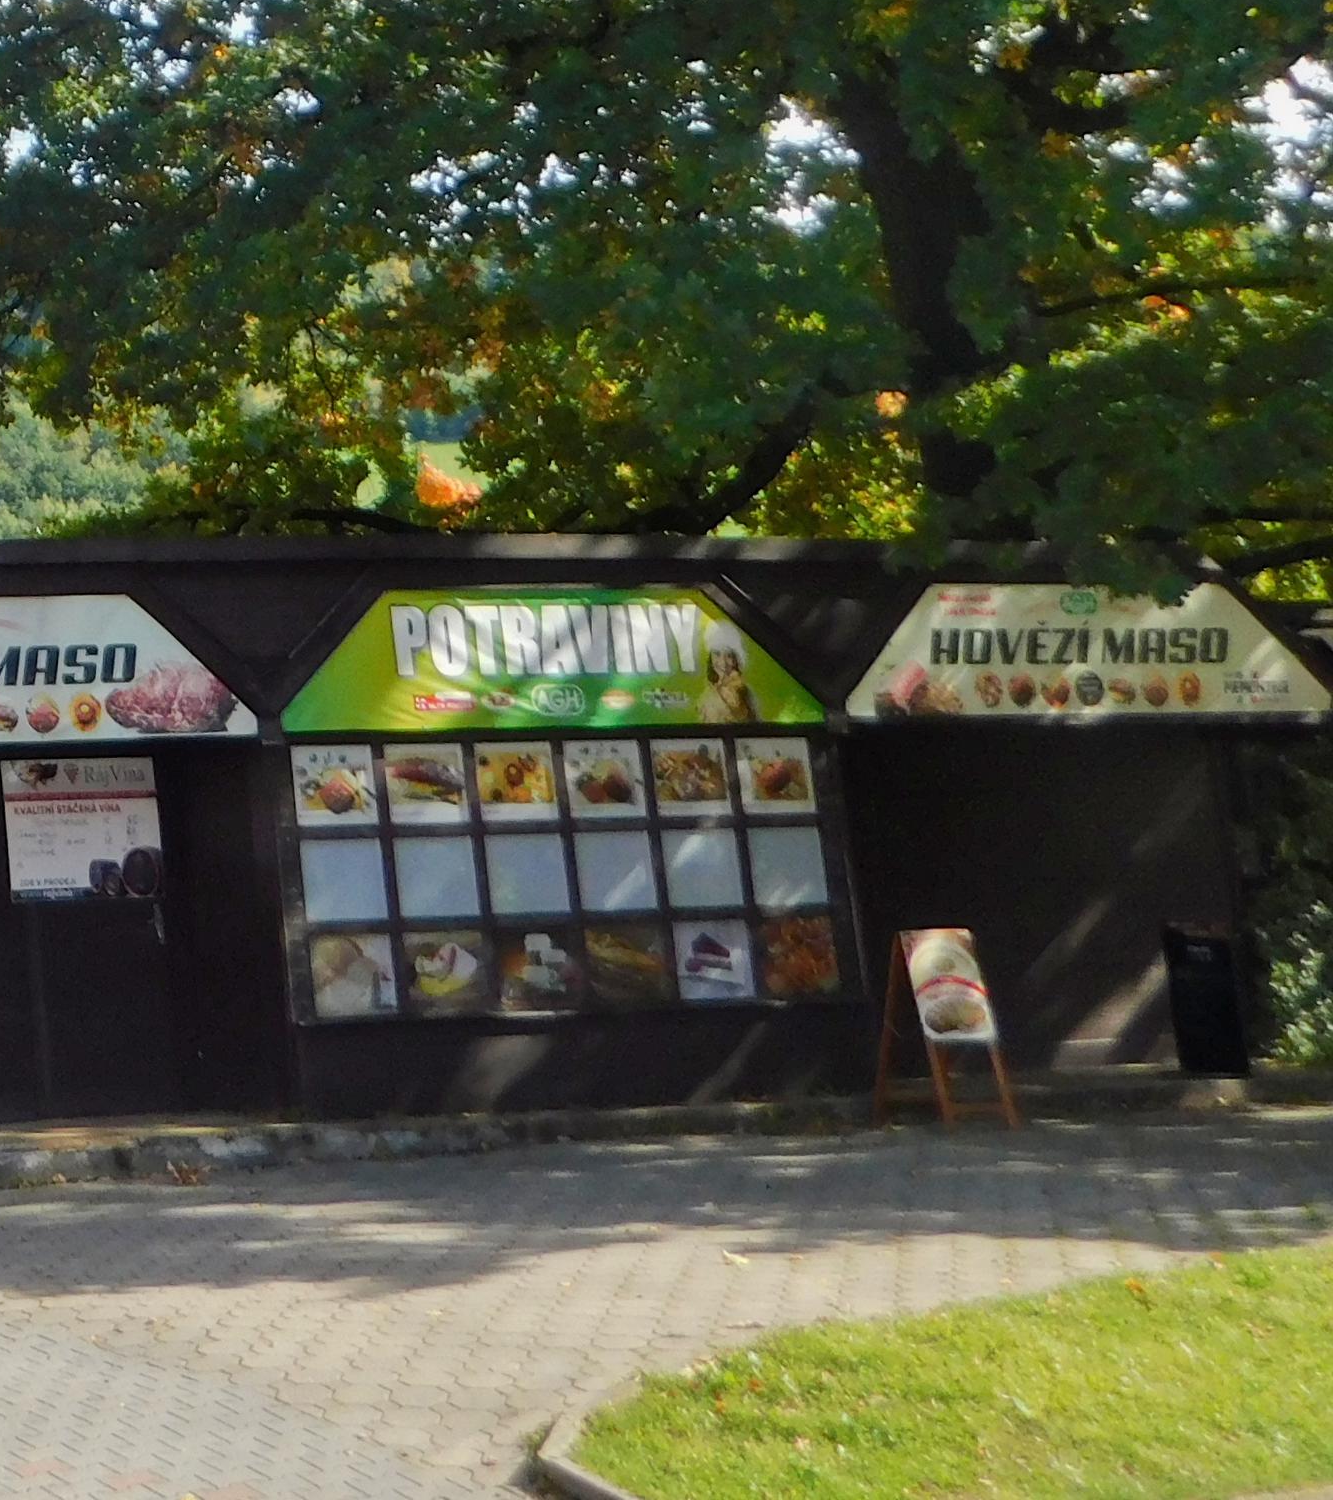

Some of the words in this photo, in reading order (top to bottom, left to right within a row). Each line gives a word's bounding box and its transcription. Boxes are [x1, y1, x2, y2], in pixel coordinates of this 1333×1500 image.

[390, 603, 697, 678] POTRAVINY
[930, 619, 1090, 665] HOVĚZÍ
[1101, 626, 1229, 665] MASO
[536, 686, 583, 713] AGH
